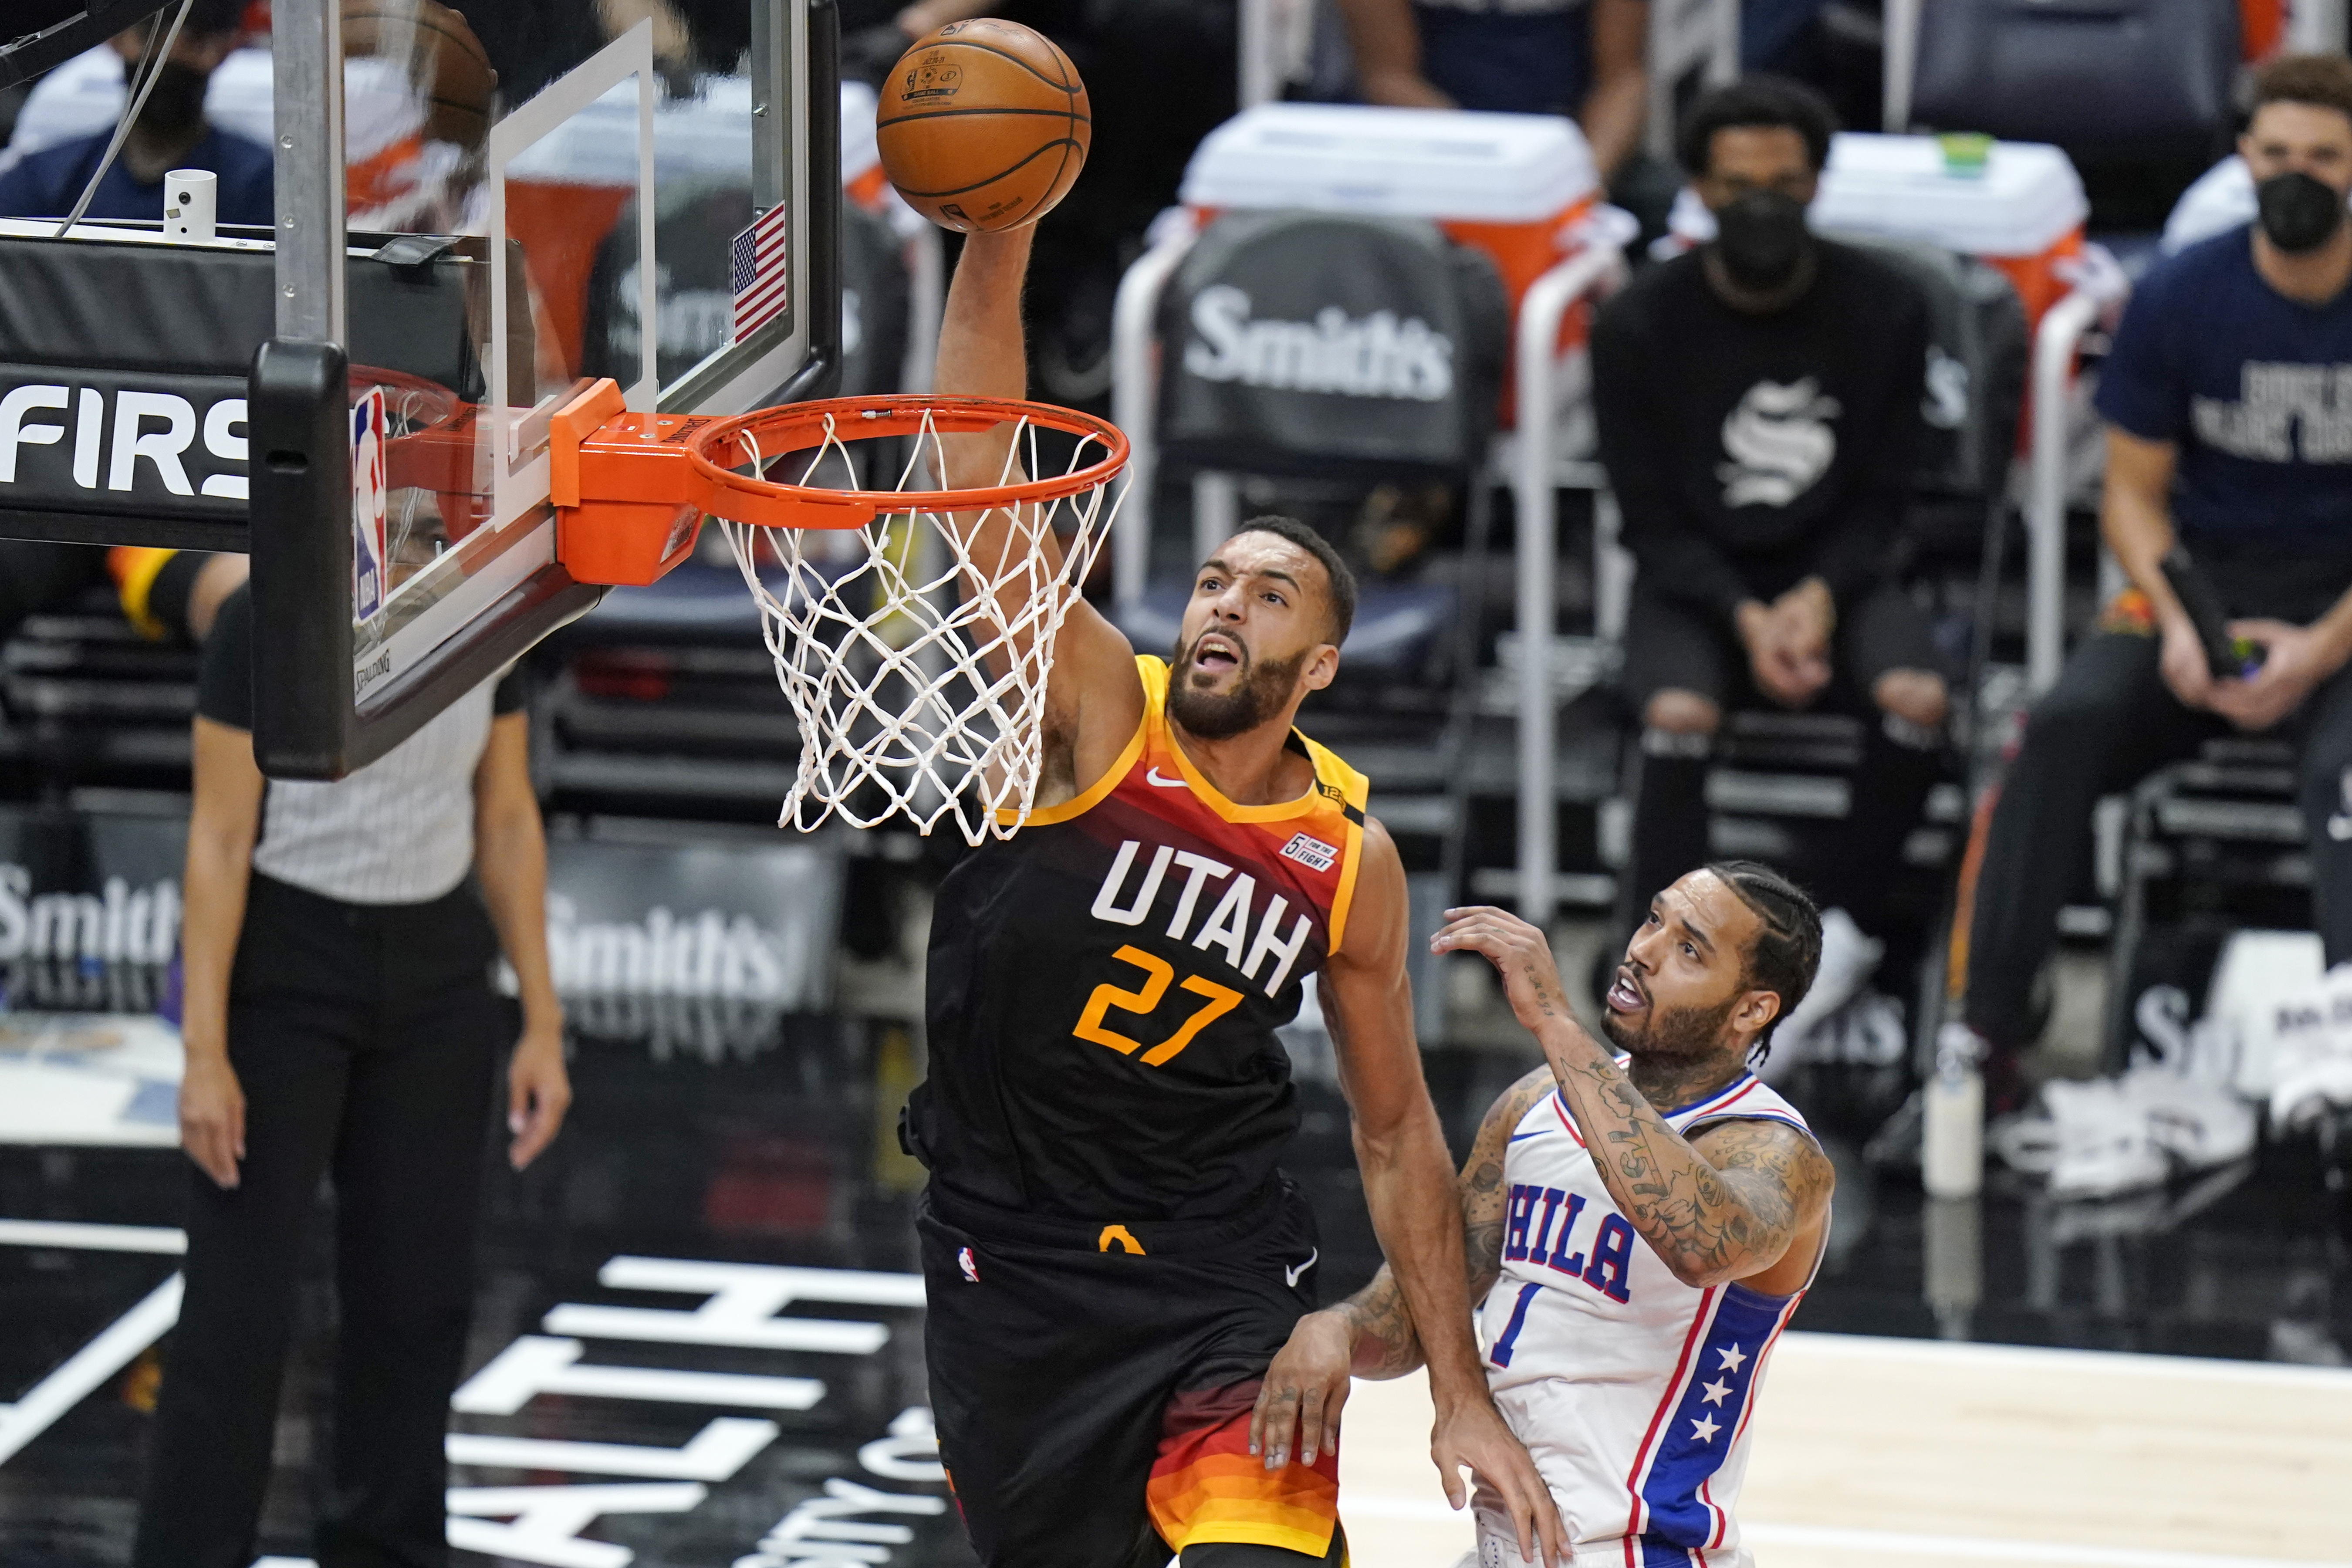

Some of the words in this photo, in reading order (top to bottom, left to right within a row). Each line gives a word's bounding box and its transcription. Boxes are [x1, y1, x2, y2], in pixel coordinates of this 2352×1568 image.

[1184, 283, 1453, 401] Smith's
[0, 385, 250, 499] FIRS
[356, 648, 390, 695] SPALDING
[1285, 836, 1305, 854] 5
[1298, 851, 1329, 868] FIGHT
[1091, 840, 1312, 998] UTAH
[1073, 944, 1244, 1067] 27
[1505, 1184, 1635, 1304] HILA
[1490, 1282, 1544, 1369] 1
[443, 1254, 927, 1568] ALTH
